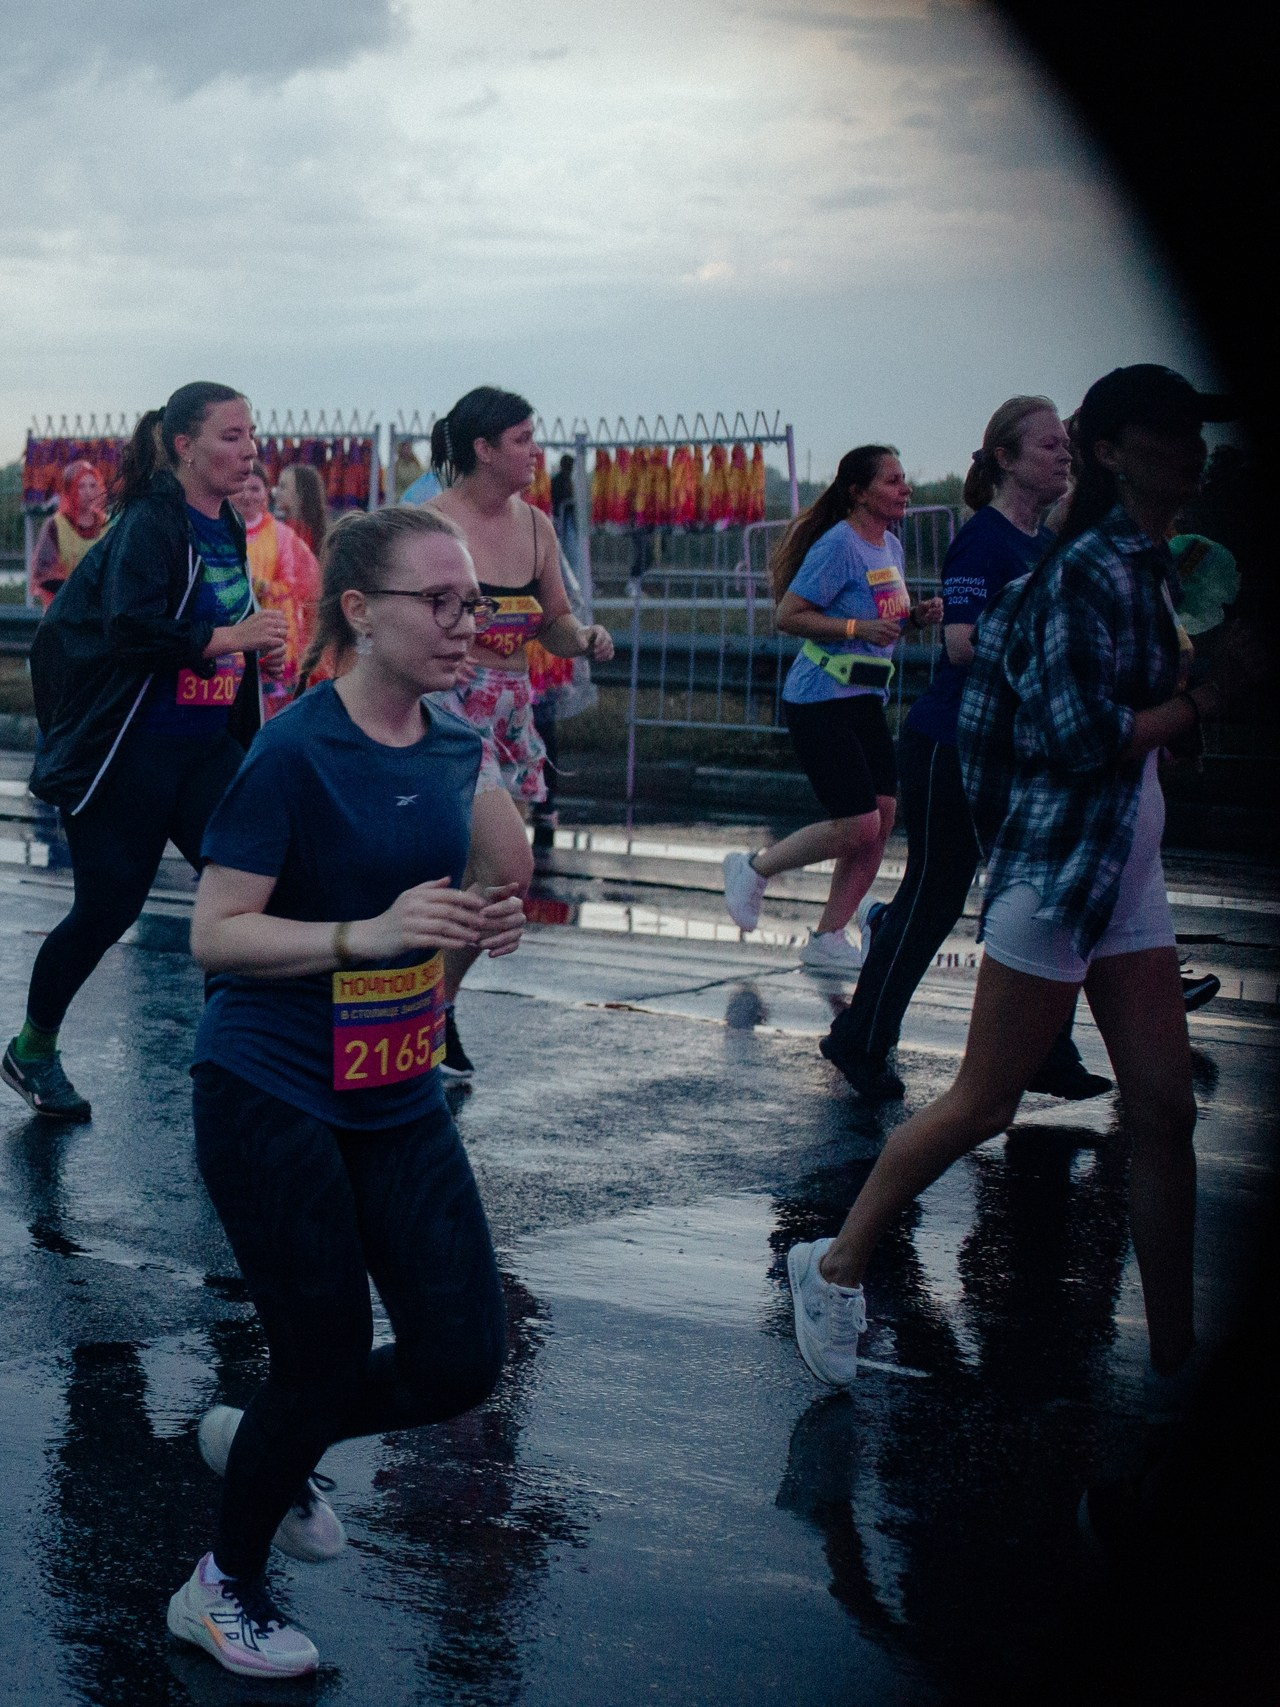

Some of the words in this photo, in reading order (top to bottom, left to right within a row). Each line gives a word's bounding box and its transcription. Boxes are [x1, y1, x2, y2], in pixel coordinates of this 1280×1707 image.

[944, 576, 986, 586] ИЖНИЙ
[943, 586, 988, 599] ОВГОРОД
[948, 596, 969, 605] 2024
[183, 675, 234, 700] 3120
[340, 973, 416, 996] НОЧНОЙ
[344, 1025, 431, 1080] 2165
